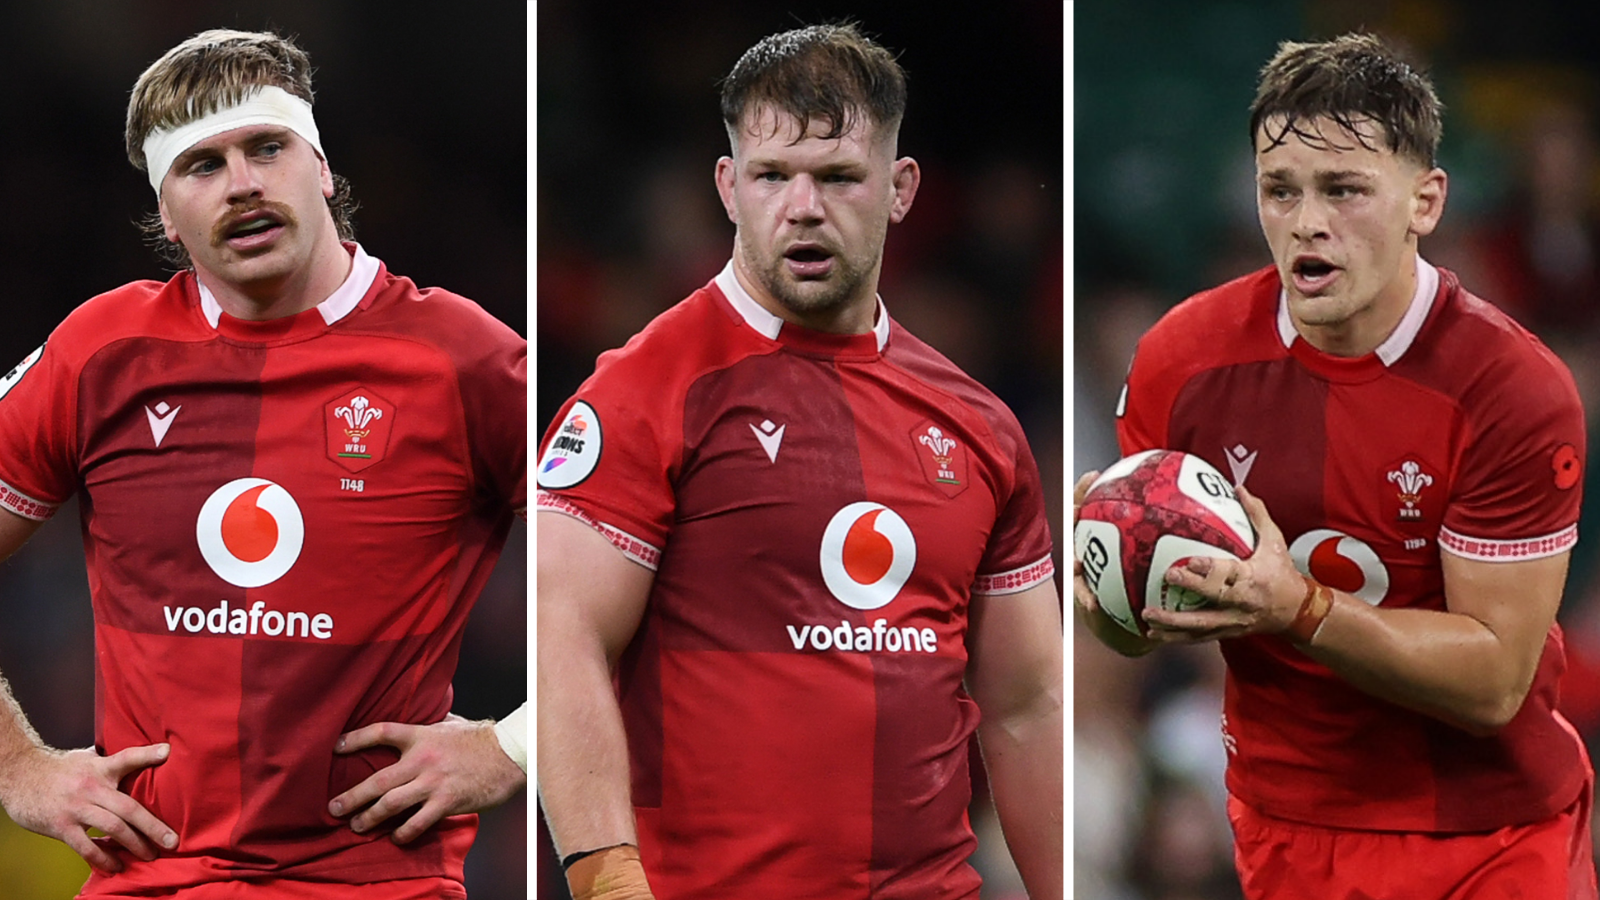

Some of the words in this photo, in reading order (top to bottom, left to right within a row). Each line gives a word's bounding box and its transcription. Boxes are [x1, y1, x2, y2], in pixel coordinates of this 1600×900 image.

[345, 443, 366, 453] WRU
[340, 478, 364, 492] 1148
[163, 600, 333, 639] vodafone
[786, 618, 938, 653] vodafone
